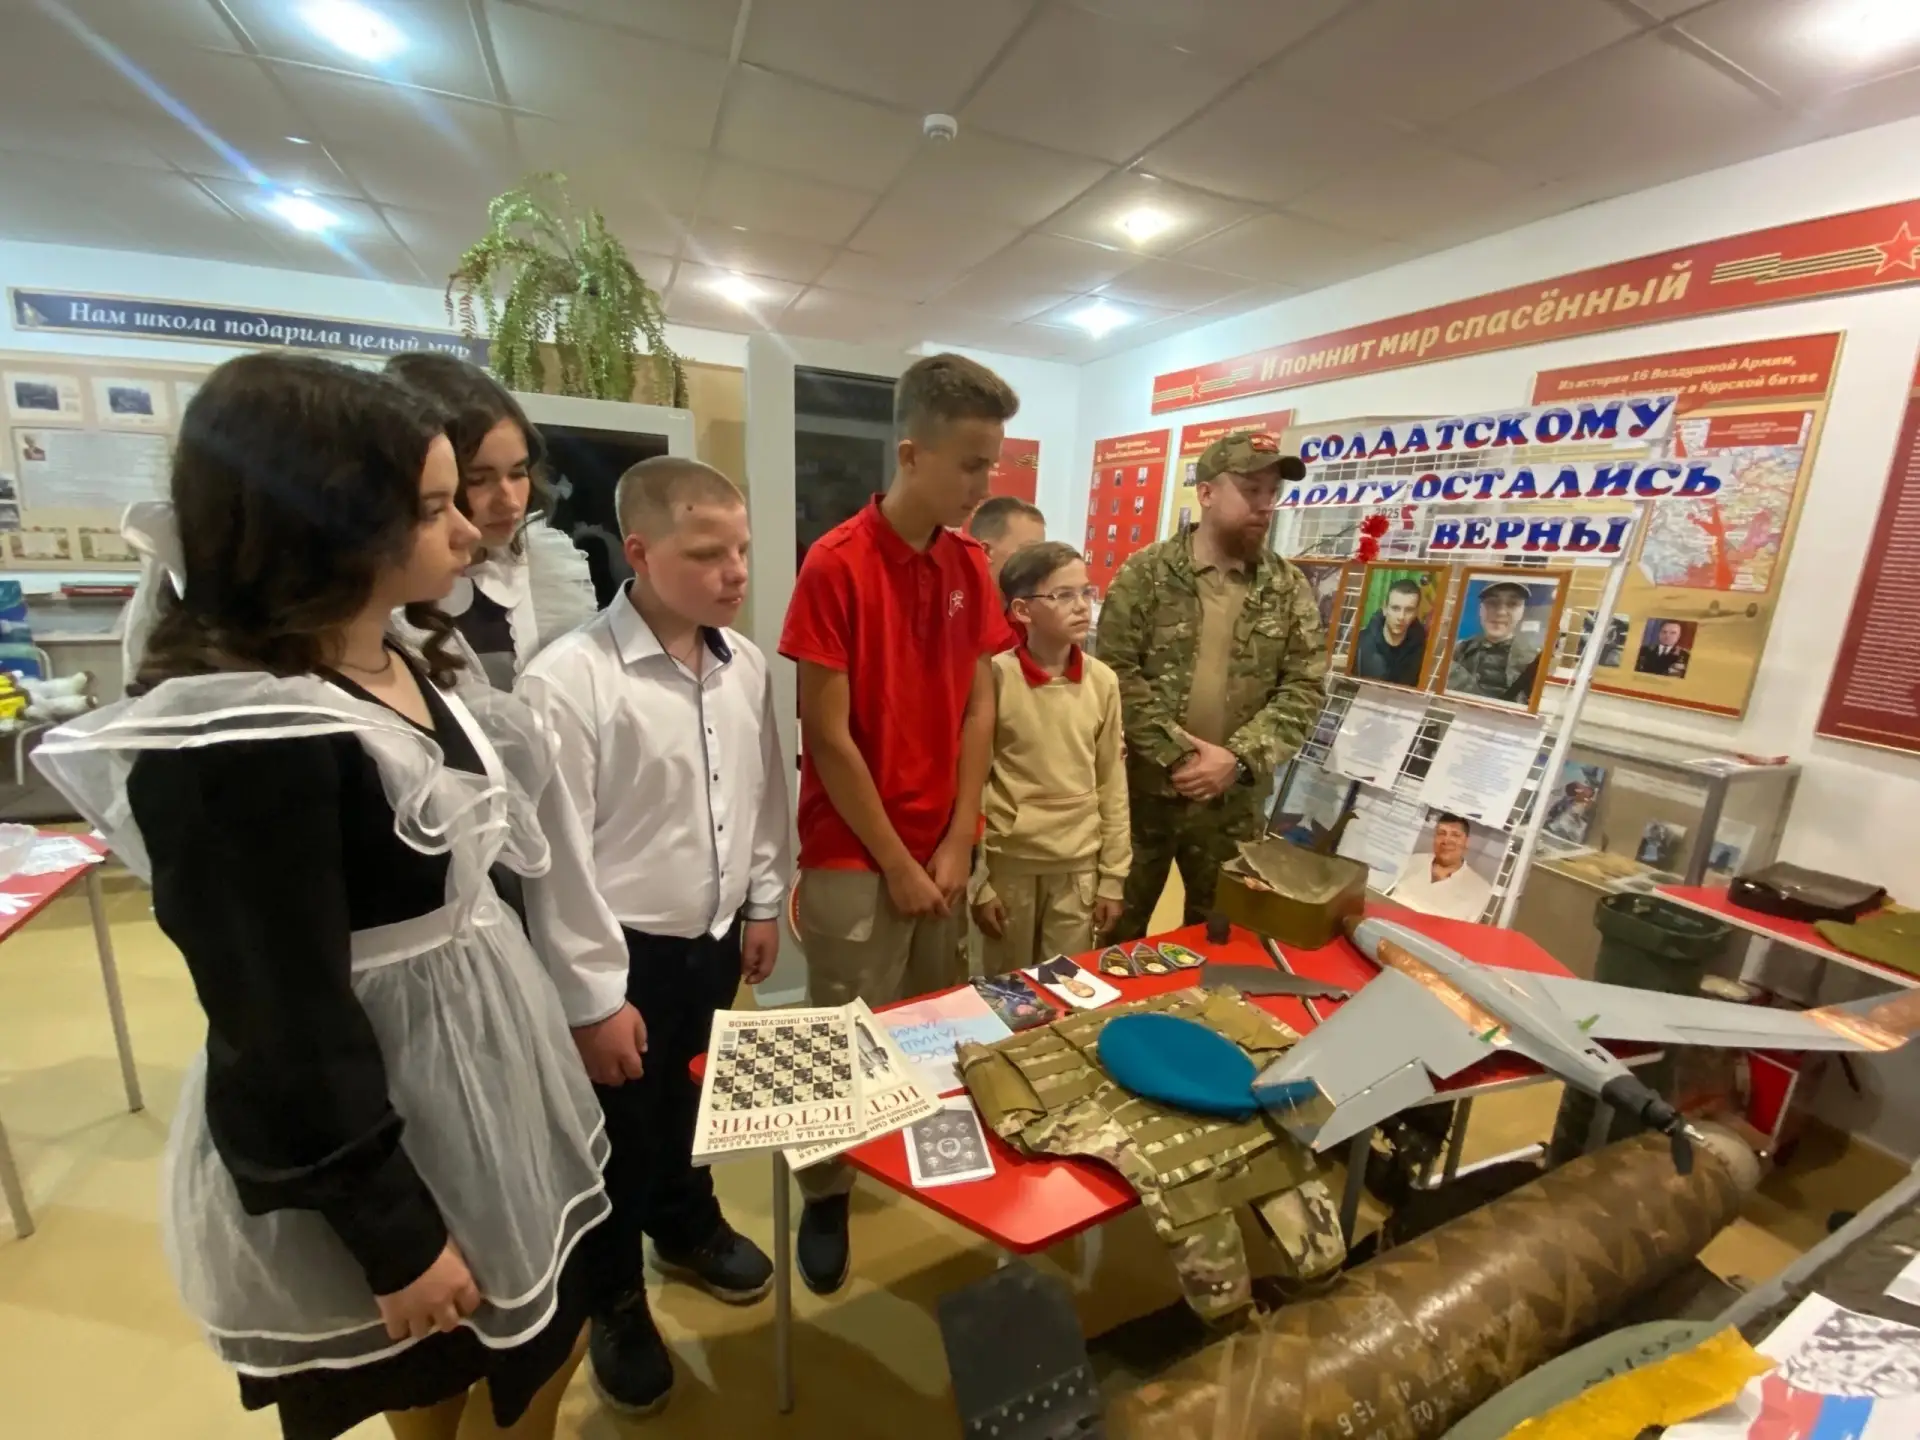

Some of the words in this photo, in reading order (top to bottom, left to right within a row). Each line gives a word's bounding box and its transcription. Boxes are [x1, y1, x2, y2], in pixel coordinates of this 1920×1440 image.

[69, 301, 127, 325] Нам
[133, 311, 217, 333] школа
[223, 317, 342, 345] подарила
[349, 333, 420, 352] целый
[1260, 355, 1279, 381] И
[1279, 339, 1376, 376] помнит
[1378, 325, 1440, 357] мир
[1445, 259, 1692, 343] спасённый
[1651, 358, 1739, 380] Воздушной
[1699, 375, 1766, 395] Курской
[1768, 372, 1819, 387] битве
[1301, 396, 1677, 464] СОЛДАТСКОМУ
[1277, 480, 1408, 508] ДОЛГУ
[1411, 461, 1722, 501] ОСТАЛИСЬ
[1375, 507, 1400, 519] 2025
[1429, 516, 1632, 550] ВЕРНЫ
[803, 1014, 840, 1024] ВЛАСТЬ
[710, 1105, 852, 1136] ИСТОРИК
[796, 1126, 856, 1139] ЦАРИЦА
